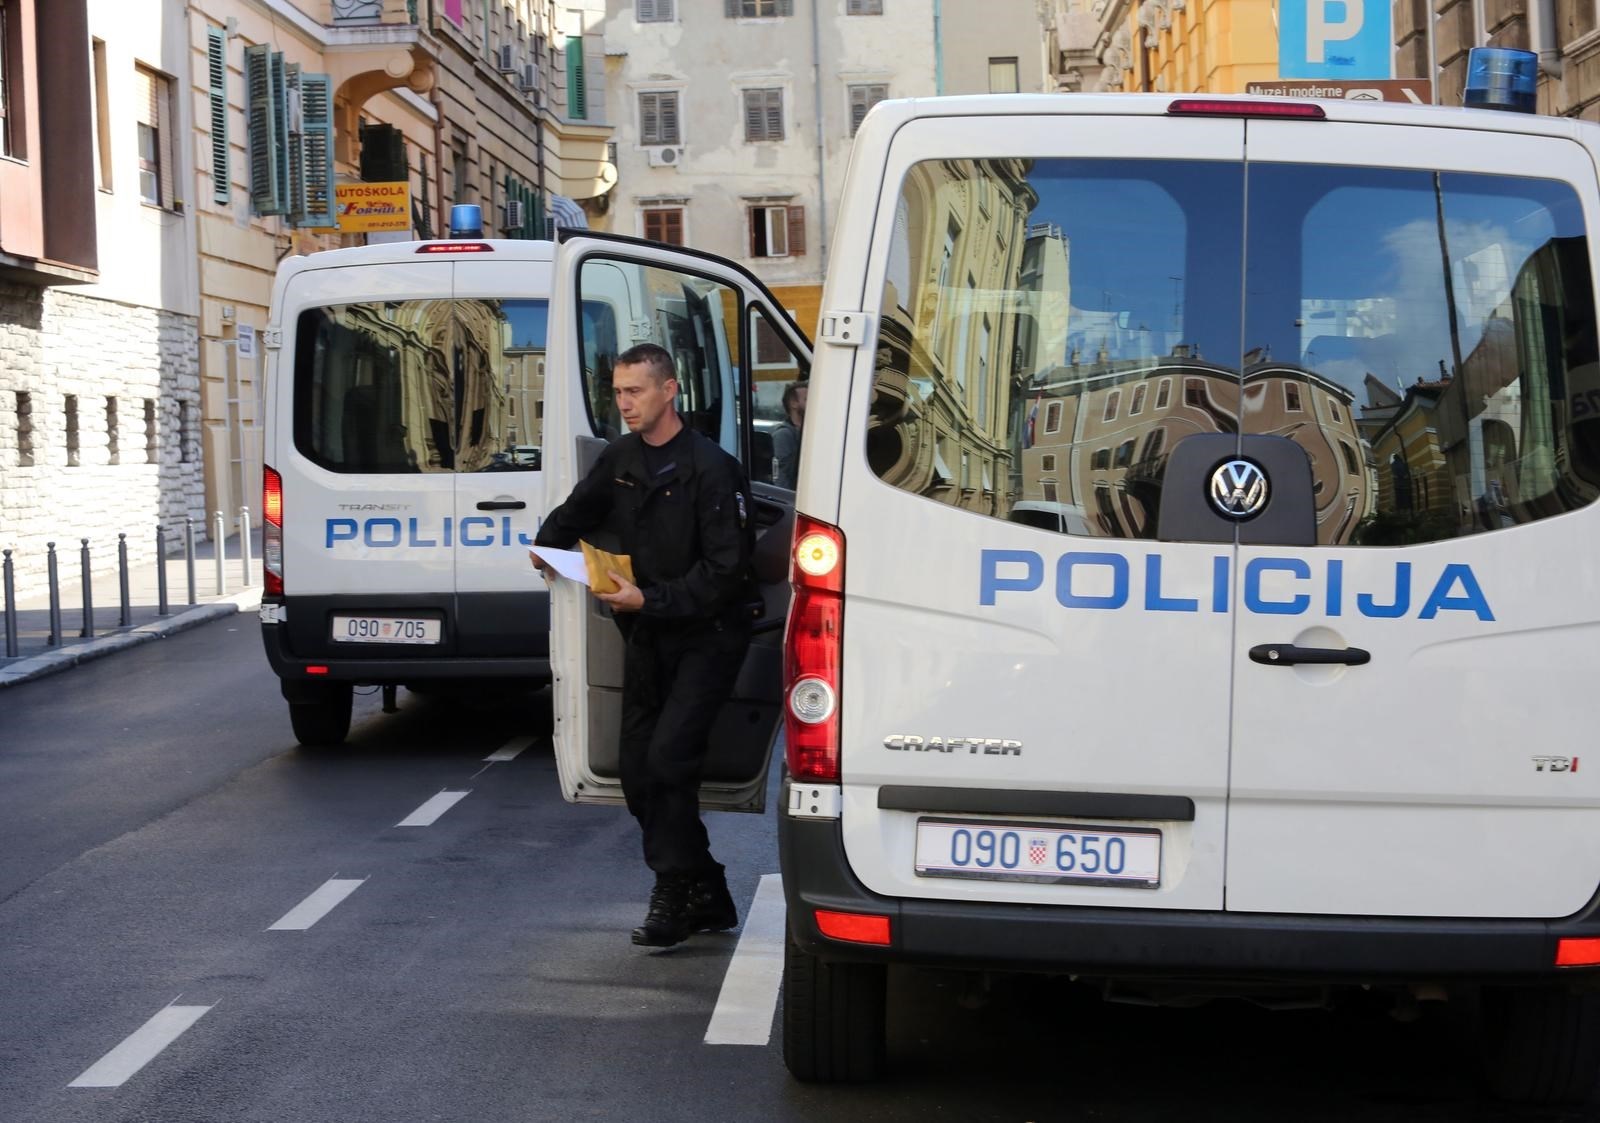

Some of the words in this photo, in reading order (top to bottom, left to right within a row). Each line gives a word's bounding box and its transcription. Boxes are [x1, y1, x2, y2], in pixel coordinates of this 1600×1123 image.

[1306, 0, 1364, 63] P
[1289, 85, 1342, 97] moderne
[338, 503, 411, 511] TRANSIT
[979, 548, 1496, 622] POLICIJA
[348, 619, 379, 637] 090
[394, 621, 425, 638] 705
[883, 734, 1023, 756] CRAFTER
[1531, 755, 1578, 772] TDI
[951, 829, 1020, 869] 090
[1056, 834, 1125, 875] 650
